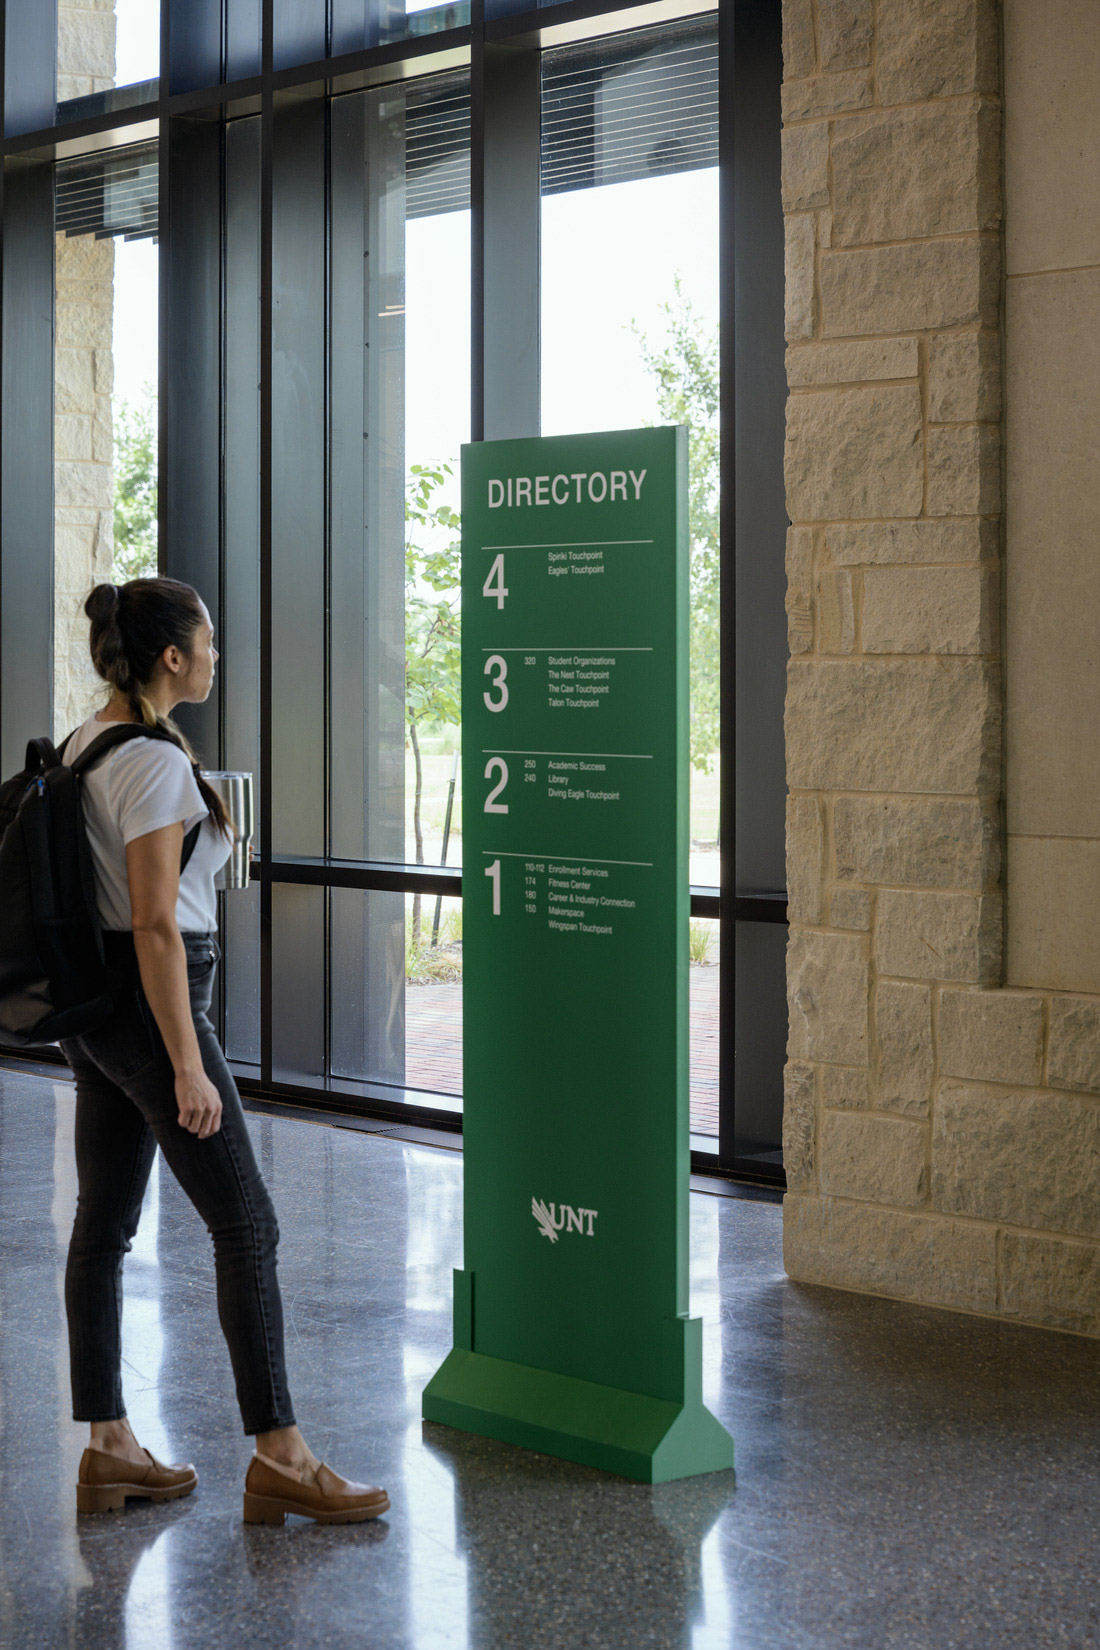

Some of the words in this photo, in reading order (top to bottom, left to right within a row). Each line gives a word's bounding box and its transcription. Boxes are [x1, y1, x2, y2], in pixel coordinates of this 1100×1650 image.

[487, 469, 648, 509] DIRECTORY
[569, 551, 603, 561] Touchpoint
[571, 565, 605, 575] Touchpoint
[482, 553, 509, 610] 4
[524, 656, 537, 666] 320
[548, 656, 572, 666] Student
[573, 656, 616, 668] Organizations
[548, 670, 560, 679] The
[560, 670, 575, 680] Nest
[576, 670, 610, 681] Touchpoint
[483, 654, 510, 713] 3
[548, 684, 560, 693] The
[561, 684, 574, 694] Caw
[576, 684, 610, 695] Touchpoint
[548, 698, 565, 707] Talon
[566, 698, 600, 709] Touchpoint
[524, 759, 537, 769] 250
[548, 760, 578, 770] Academic
[579, 761, 606, 772] Success
[483, 756, 509, 815] 2
[524, 773, 537, 783] 240
[548, 774, 569, 786] Library
[548, 788, 567, 800] Diving
[568, 788, 585, 800] Eagle
[585, 789, 620, 801] Touchpoint
[524, 863, 545, 873] 110-112
[548, 864, 581, 876] Enrollment
[581, 866, 609, 878] Services
[484, 859, 501, 915] 1
[524, 876, 537, 886] 174
[548, 878, 570, 889] Fitness
[570, 880, 591, 891] Center
[524, 890, 537, 900] 180
[548, 892, 569, 903] Career
[575, 895, 600, 907] Industry
[600, 897, 636, 909] Connection
[524, 904, 537, 914] 150
[548, 906, 585, 918] Makerspace
[548, 920, 578, 932] Wingspan
[579, 922, 613, 935] Touchpoint
[548, 1202, 599, 1237] UNT
